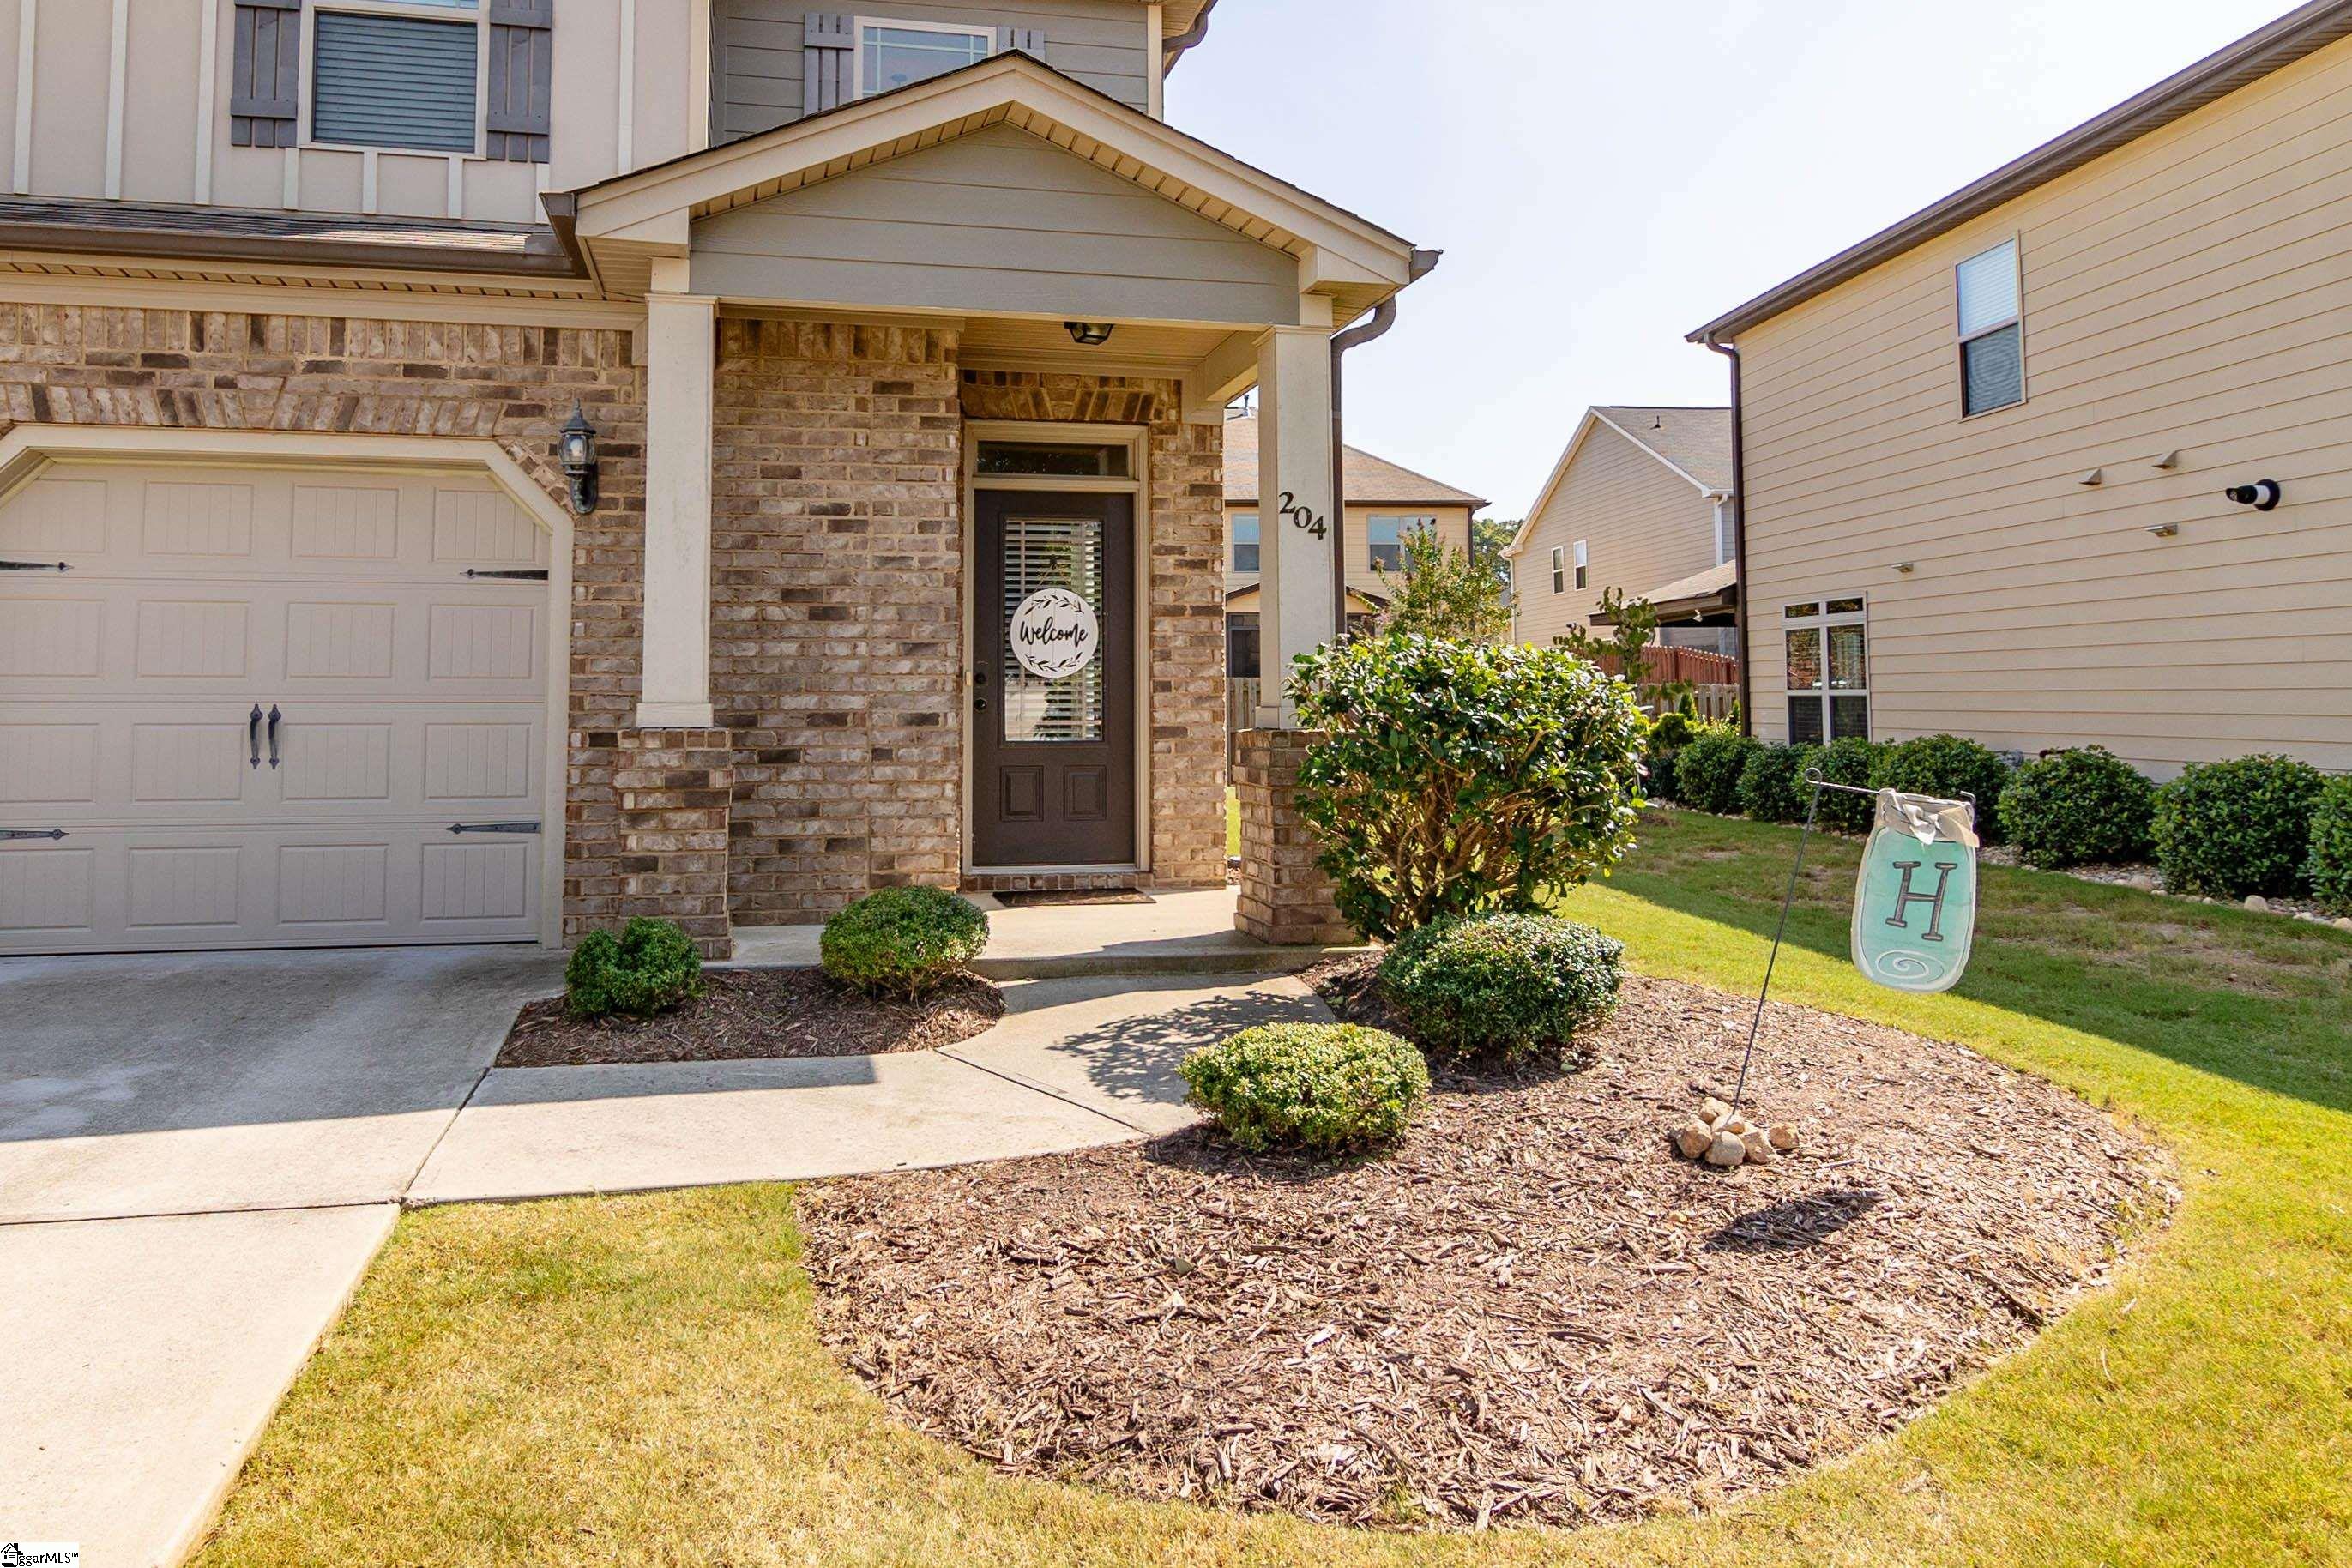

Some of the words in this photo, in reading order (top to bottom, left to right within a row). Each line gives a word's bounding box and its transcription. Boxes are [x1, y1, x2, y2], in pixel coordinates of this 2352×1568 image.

[1279, 492, 1327, 540] 204
[1020, 616, 1089, 648] Welcome
[1885, 861, 1957, 941] H
